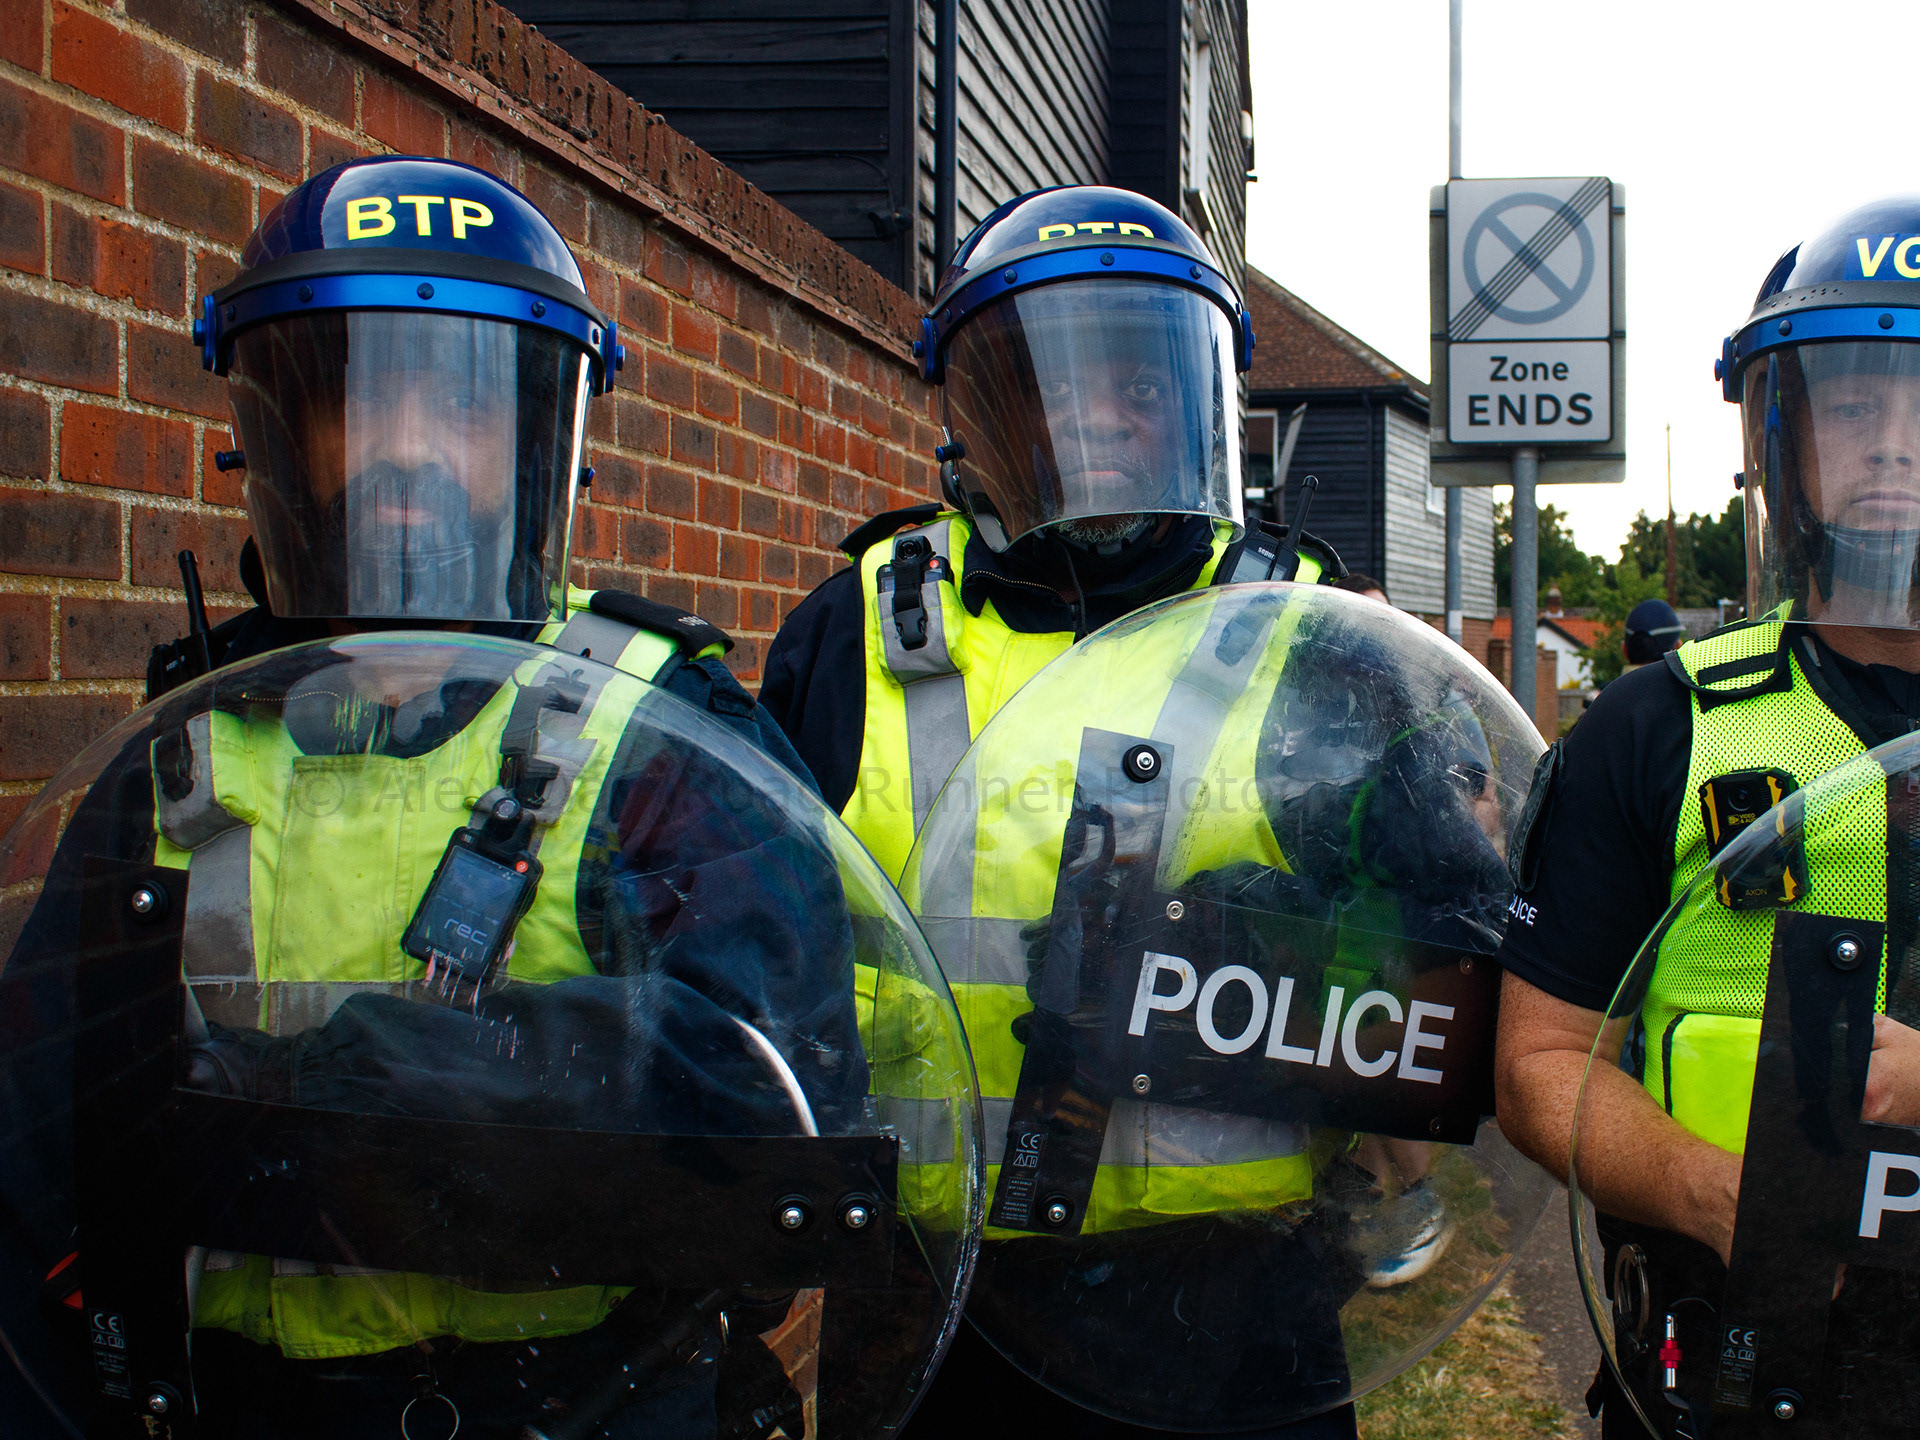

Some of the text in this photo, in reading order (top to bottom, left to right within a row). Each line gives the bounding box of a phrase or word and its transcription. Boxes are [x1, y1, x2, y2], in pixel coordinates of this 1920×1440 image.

[346, 195, 494, 241] BTP
[1490, 355, 1569, 381] Zone
[1468, 392, 1594, 426] ENDS
[1257, 546, 1276, 560] sepur
[1745, 888, 1768, 896] AXON
[443, 918, 488, 946] rec
[1128, 951, 1455, 1084] POLICE
[1858, 1150, 1920, 1239] P
